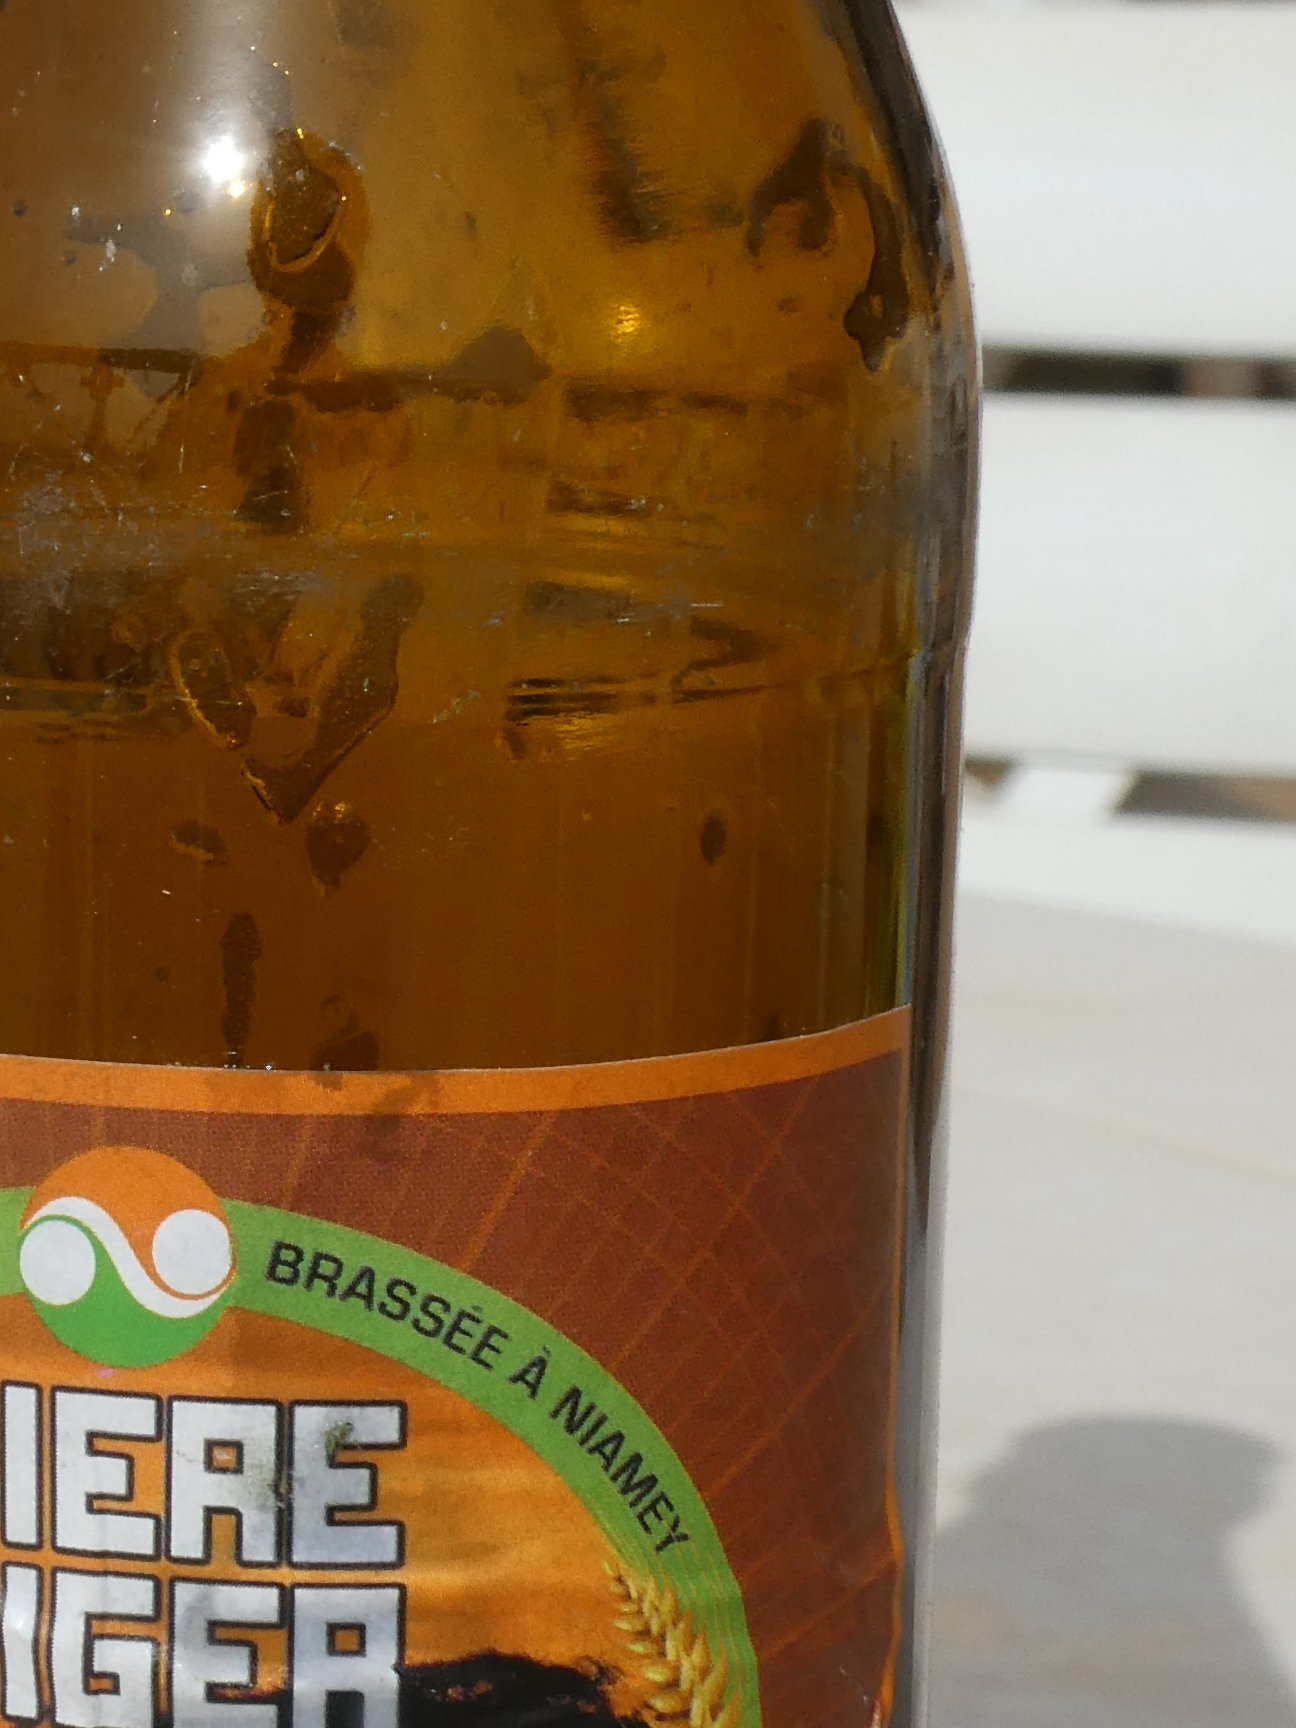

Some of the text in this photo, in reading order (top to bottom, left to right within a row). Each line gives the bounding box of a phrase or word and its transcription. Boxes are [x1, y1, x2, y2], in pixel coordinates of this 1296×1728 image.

[266, 1241, 688, 1553] BRASSÉE À NIAMEY
